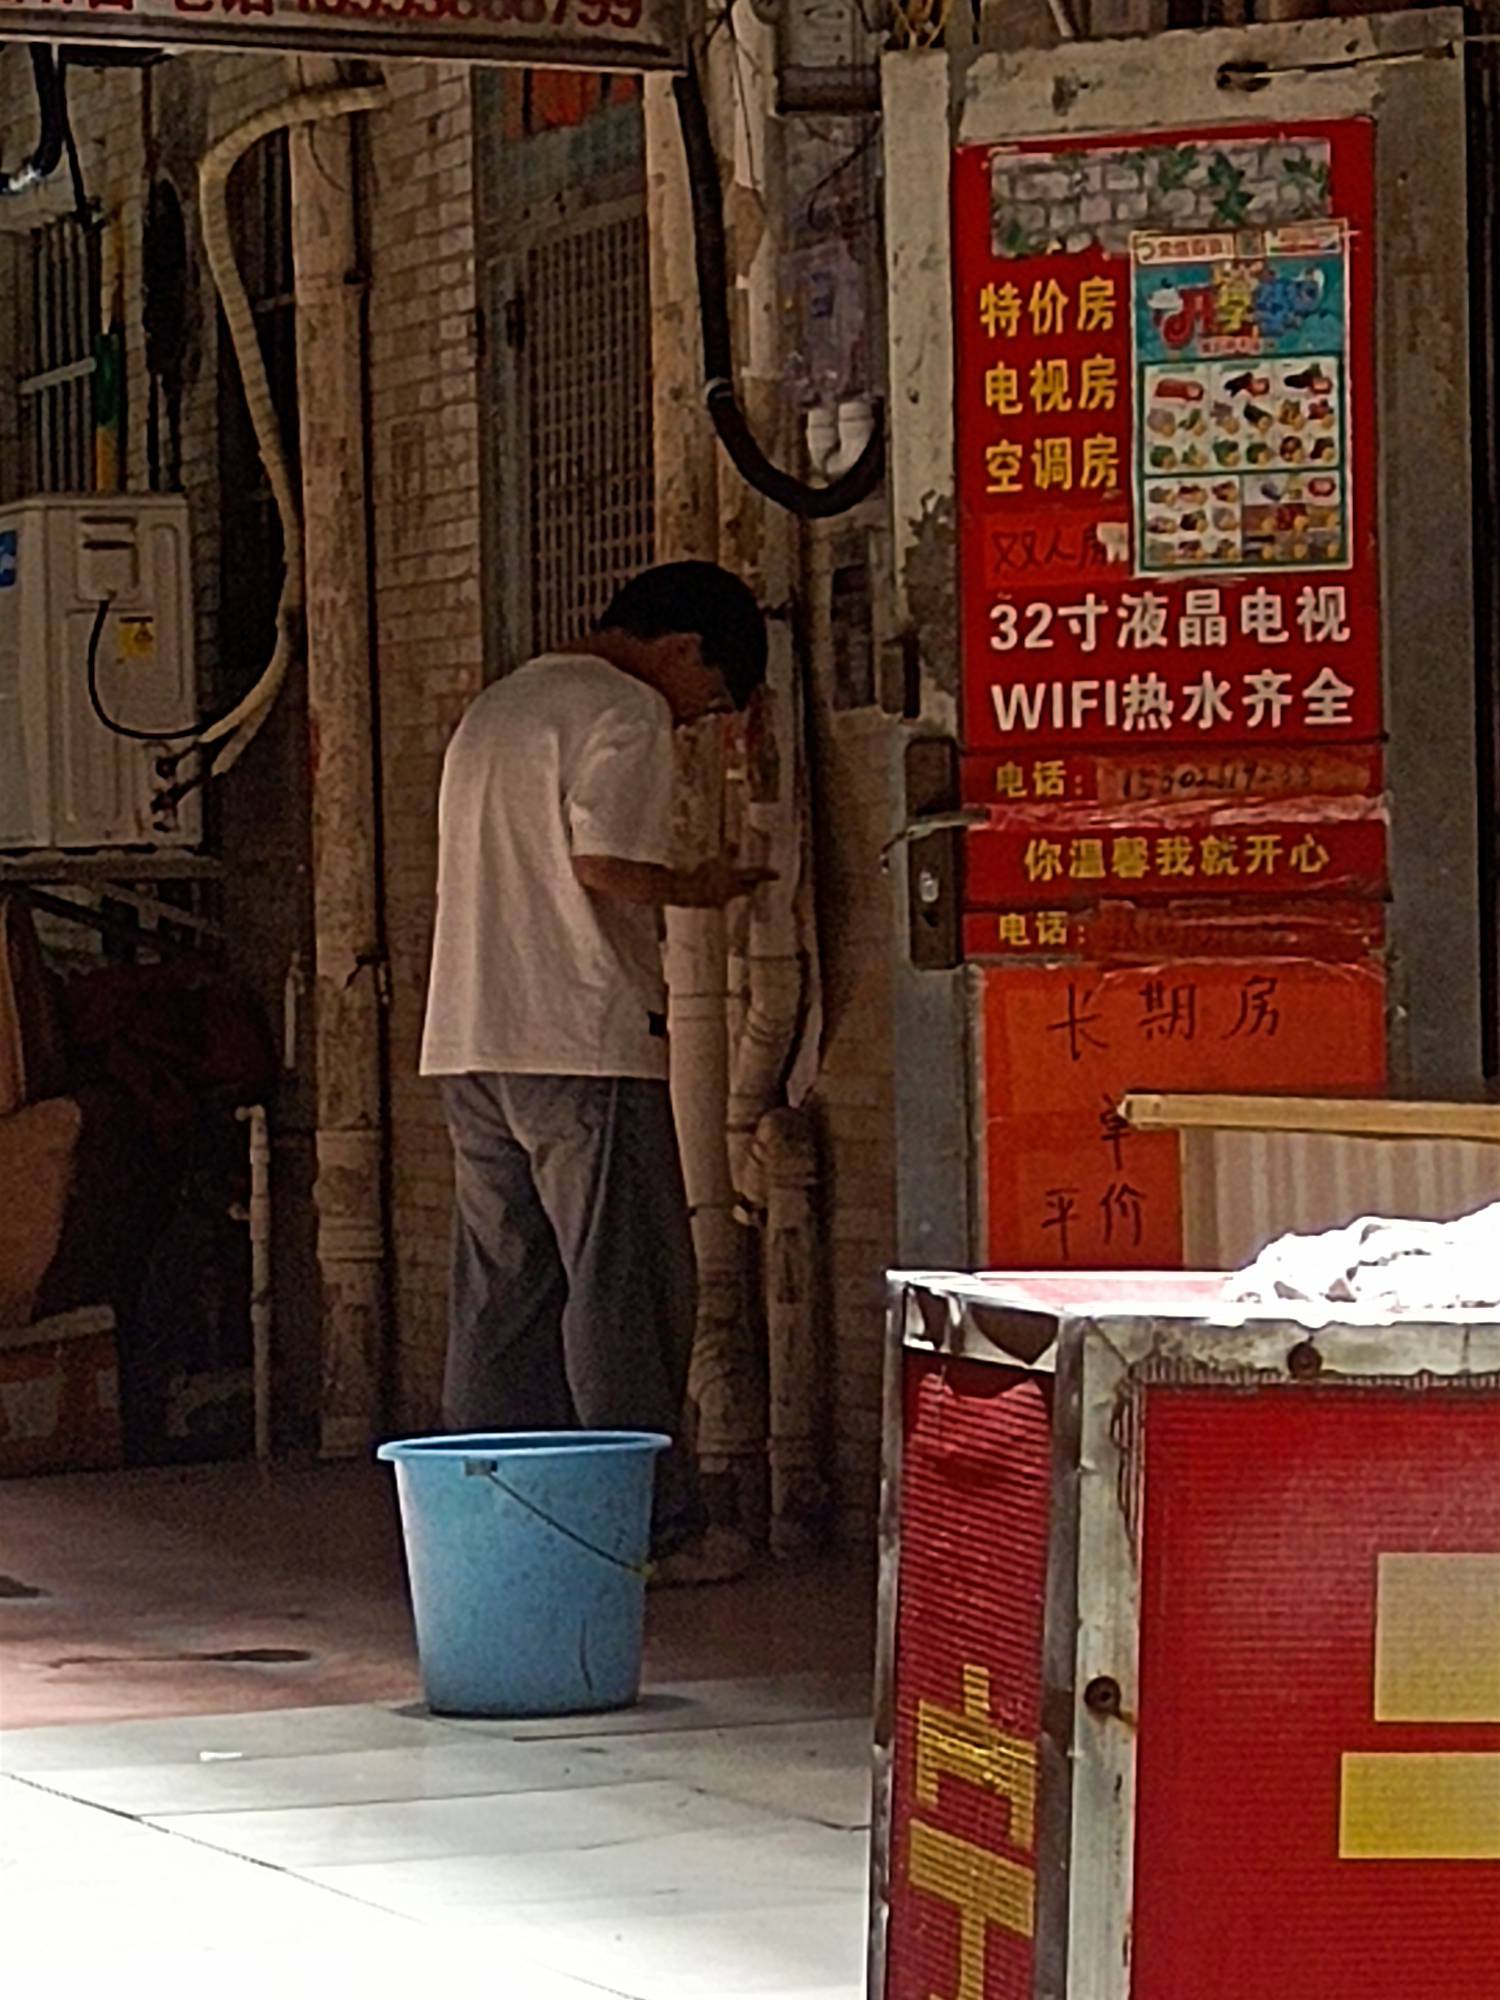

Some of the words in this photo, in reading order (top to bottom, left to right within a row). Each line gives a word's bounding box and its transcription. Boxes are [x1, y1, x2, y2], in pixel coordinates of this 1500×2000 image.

[980, 276, 1116, 338] 特价房
[985, 354, 1119, 415] 电视房
[985, 433, 1120, 493] 空调房
[989, 586, 1351, 652] 32寸液晶电视
[991, 667, 1355, 731] WIFI热水齐全
[1023, 833, 1331, 882] 你温馨我就开心
[1046, 977, 1281, 1060] 长期房
[1041, 1182, 1147, 1261] 平价
